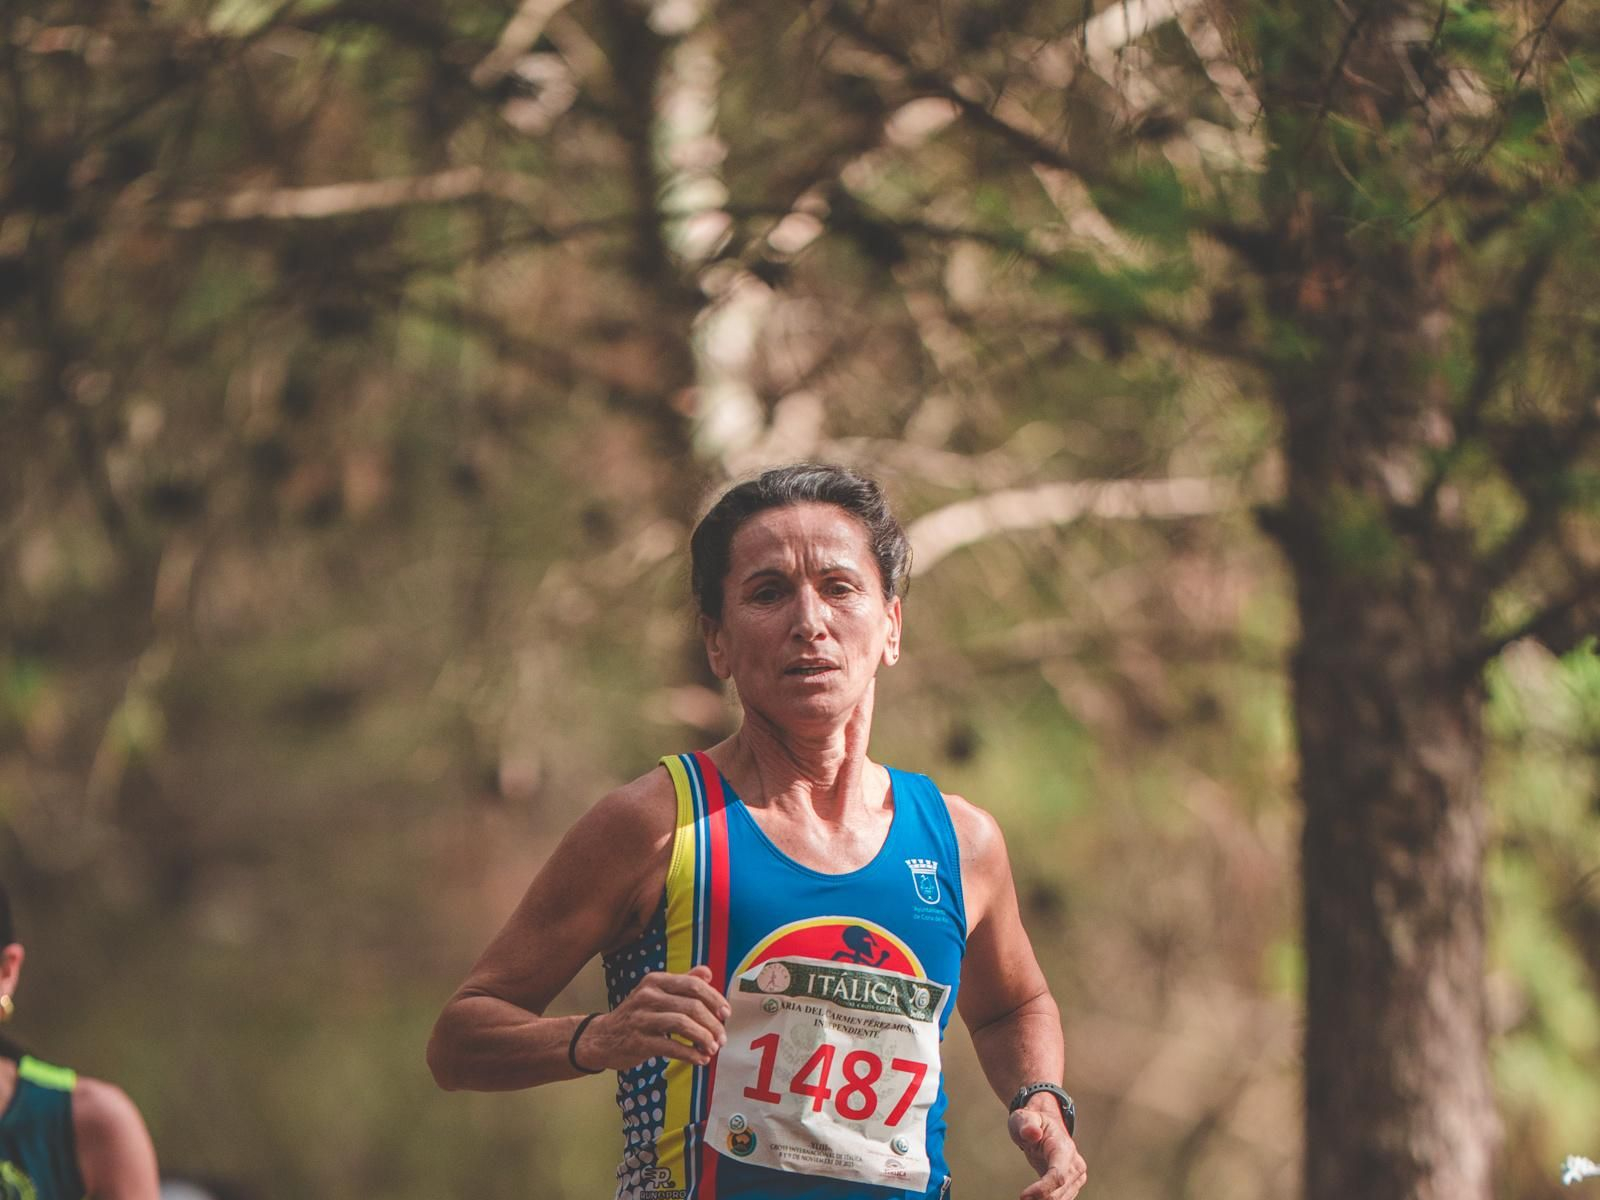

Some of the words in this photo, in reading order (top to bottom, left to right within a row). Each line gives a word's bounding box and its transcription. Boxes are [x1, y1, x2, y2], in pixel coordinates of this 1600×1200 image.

[807, 972, 899, 1008] ITÁLICA
[780, 1000, 802, 1012] ARIA
[805, 1005, 824, 1016] DEL
[825, 1009, 862, 1025] CARMEN
[813, 1018, 880, 1038] INPENDIENTE
[743, 1032, 928, 1127] 1487
